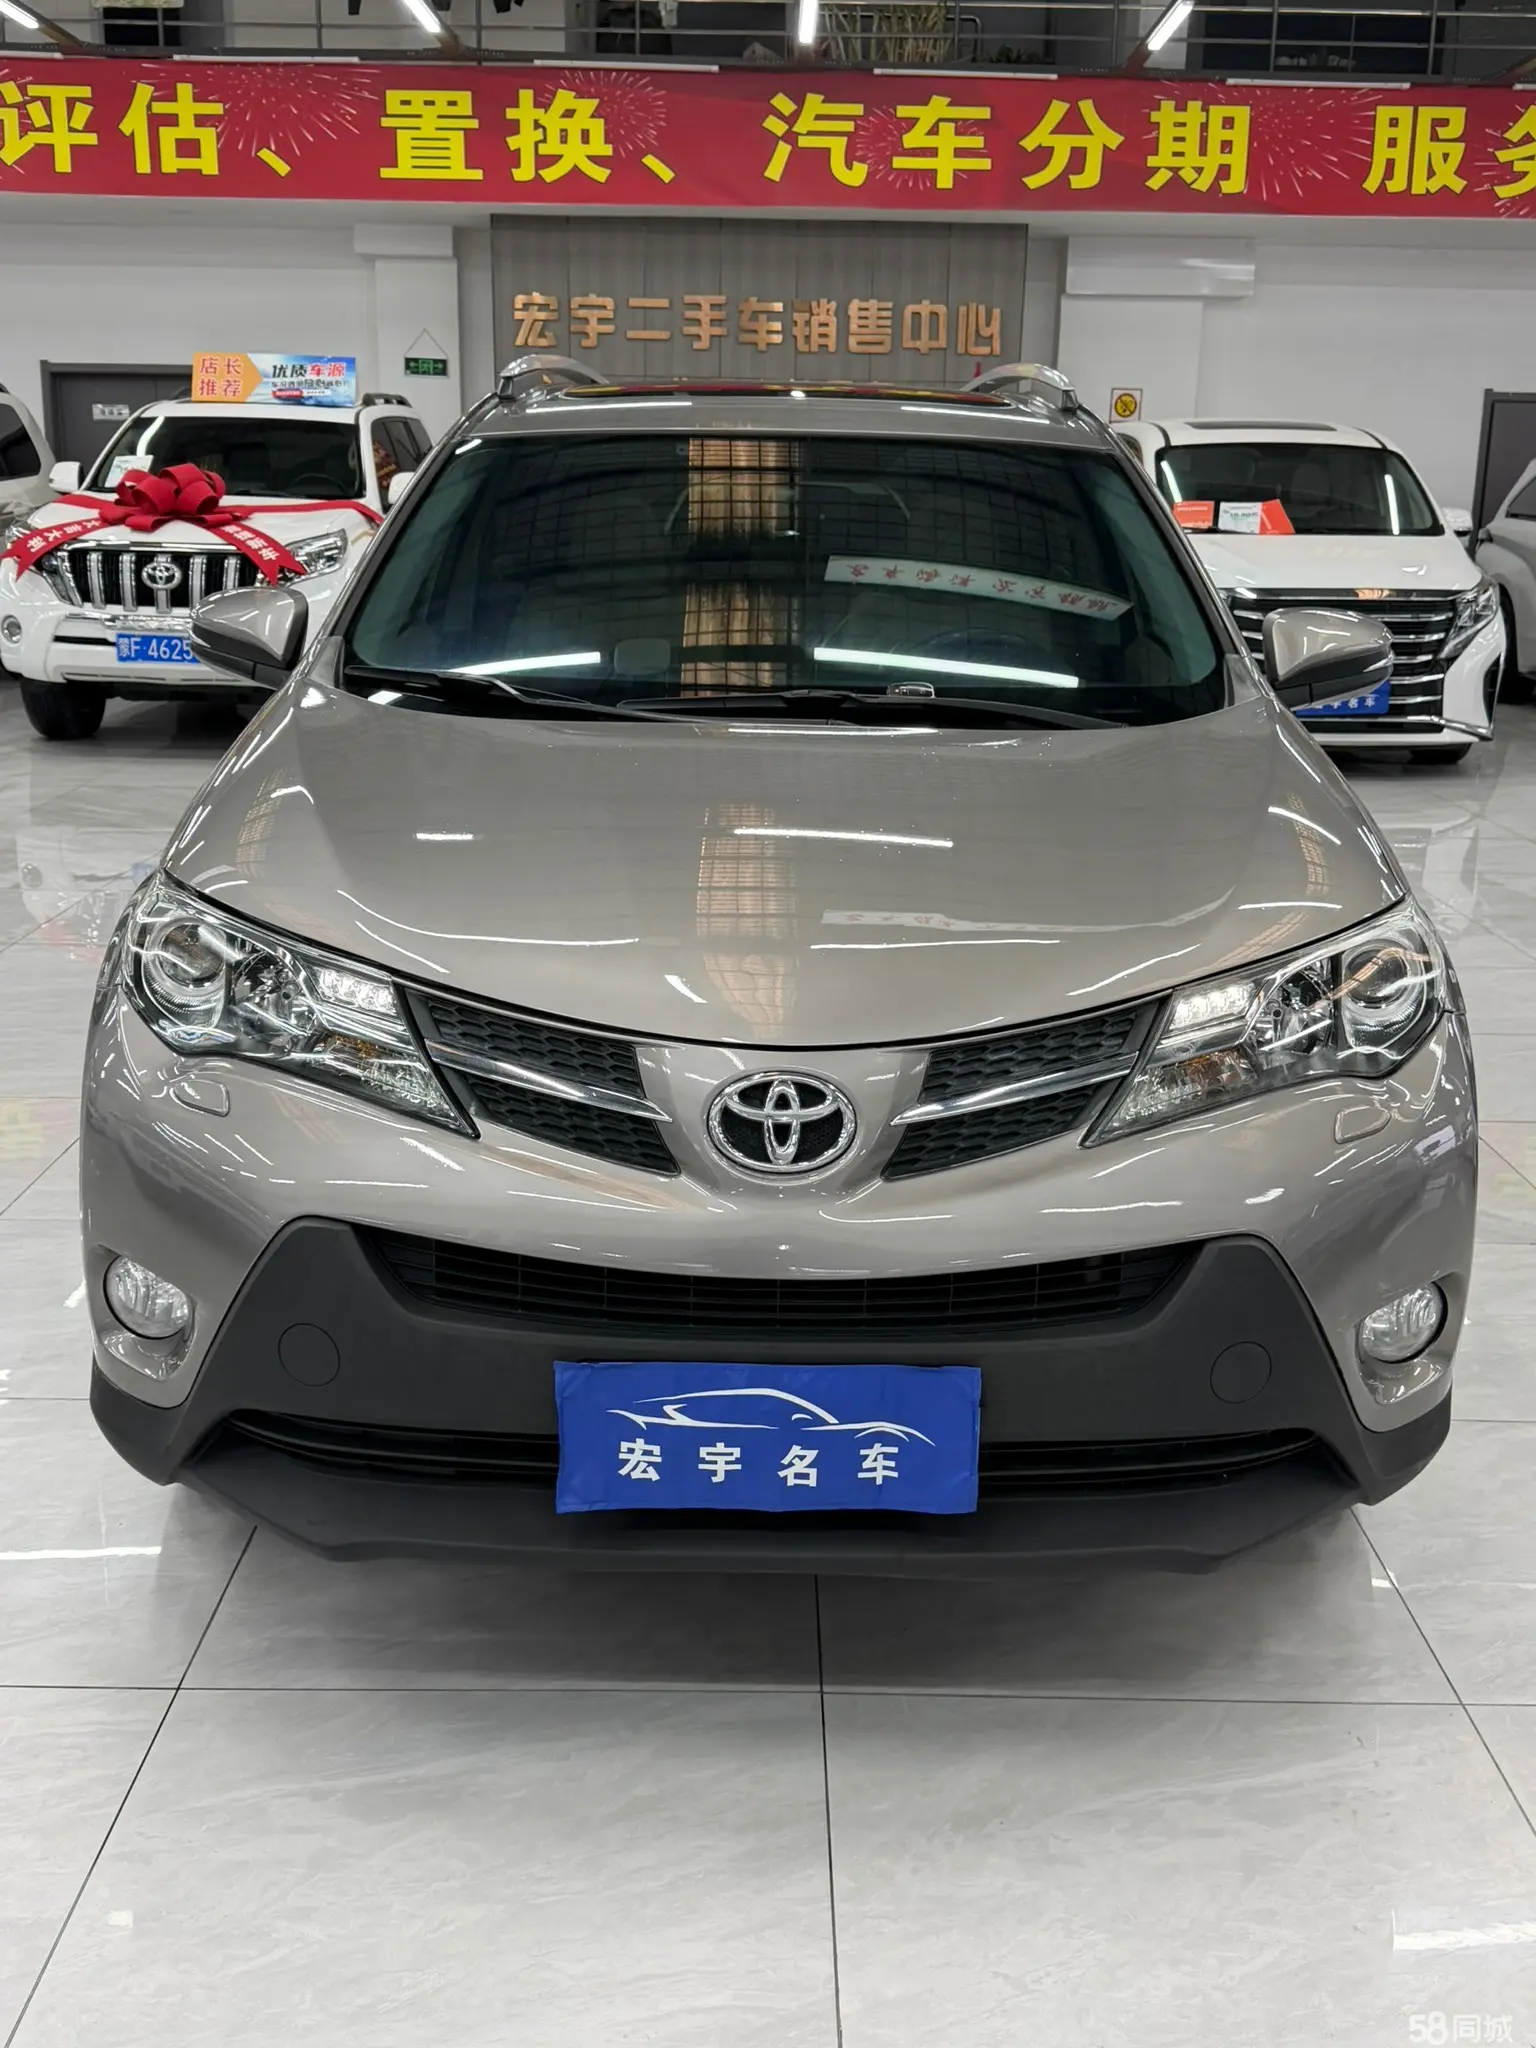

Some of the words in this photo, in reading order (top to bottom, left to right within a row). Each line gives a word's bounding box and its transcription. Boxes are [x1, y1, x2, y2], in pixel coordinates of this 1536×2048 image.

[513, 291, 1001, 357] 宏宇二手车销售中心
[200, 357, 242, 375] 店长
[271, 363, 346, 379] 优质车源
[199, 378, 242, 397] 推荐
[617, 1437, 900, 1488] 宏宇名车
